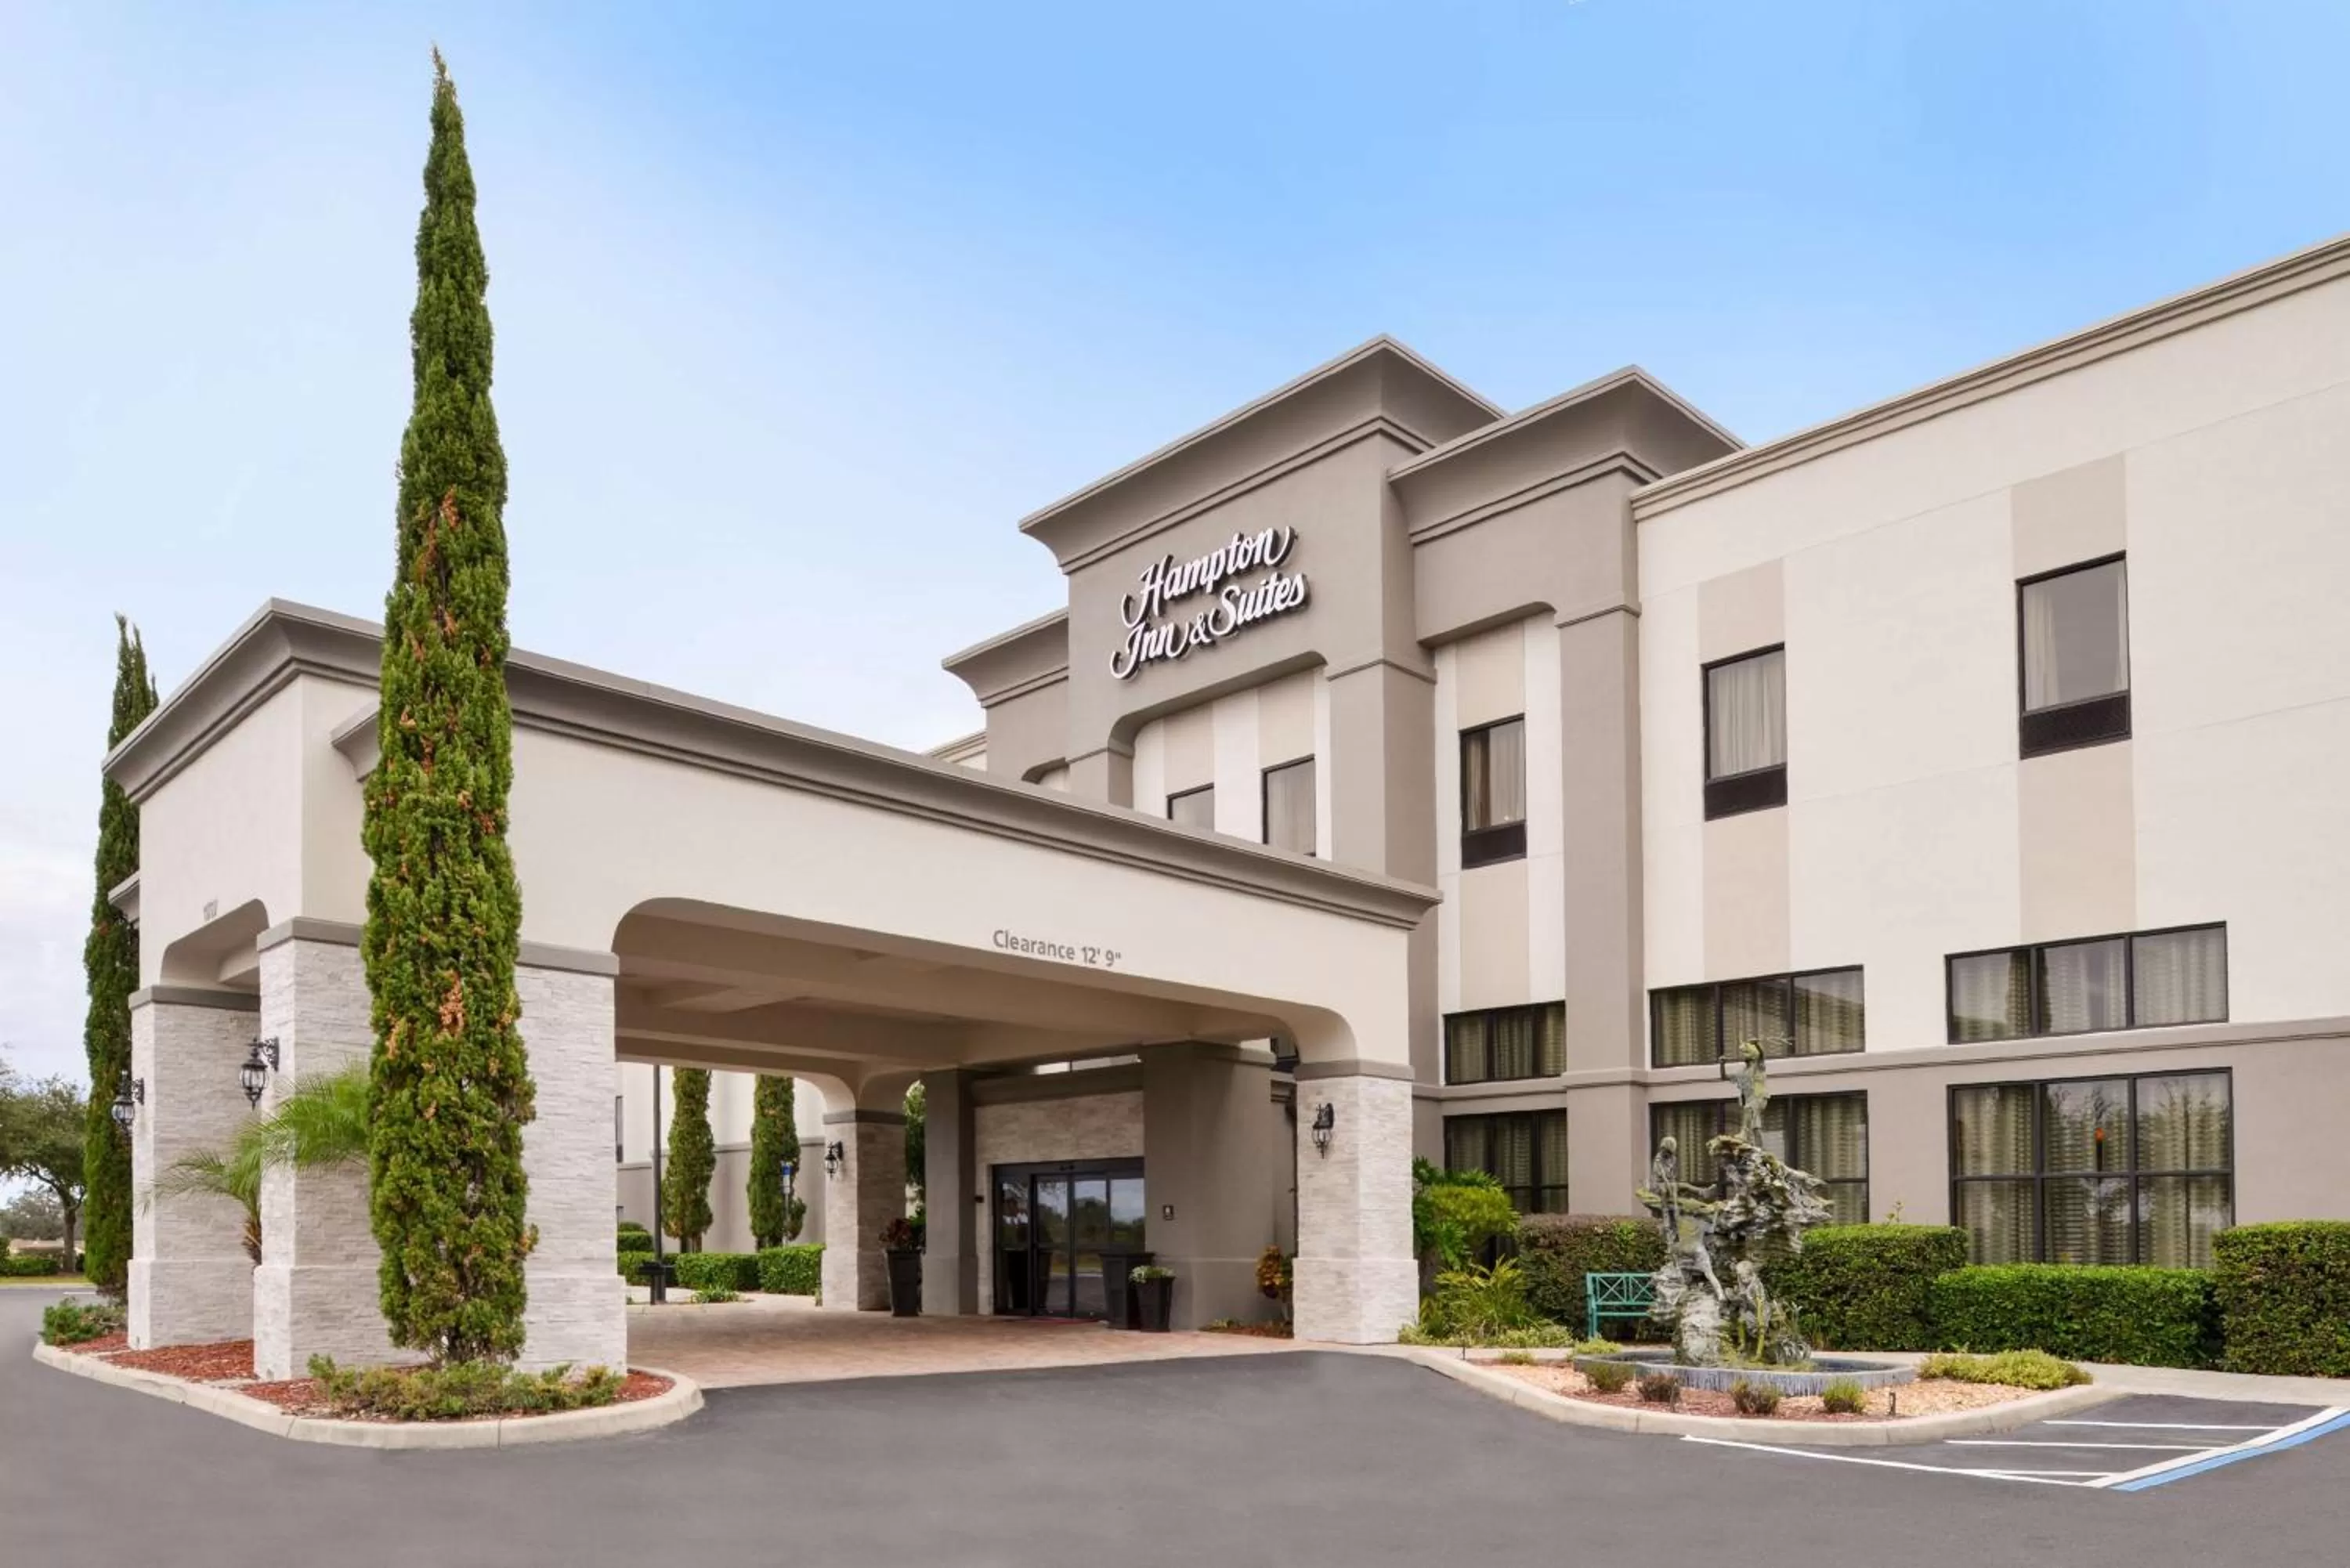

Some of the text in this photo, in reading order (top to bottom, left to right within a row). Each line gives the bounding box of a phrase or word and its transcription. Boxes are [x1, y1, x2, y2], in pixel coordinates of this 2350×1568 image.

[1109, 573, 1307, 680] Inn & Suites
[1121, 526, 1296, 627] Hampton
[992, 930, 1075, 960] Clearance
[1081, 946, 1101, 964] 12'
